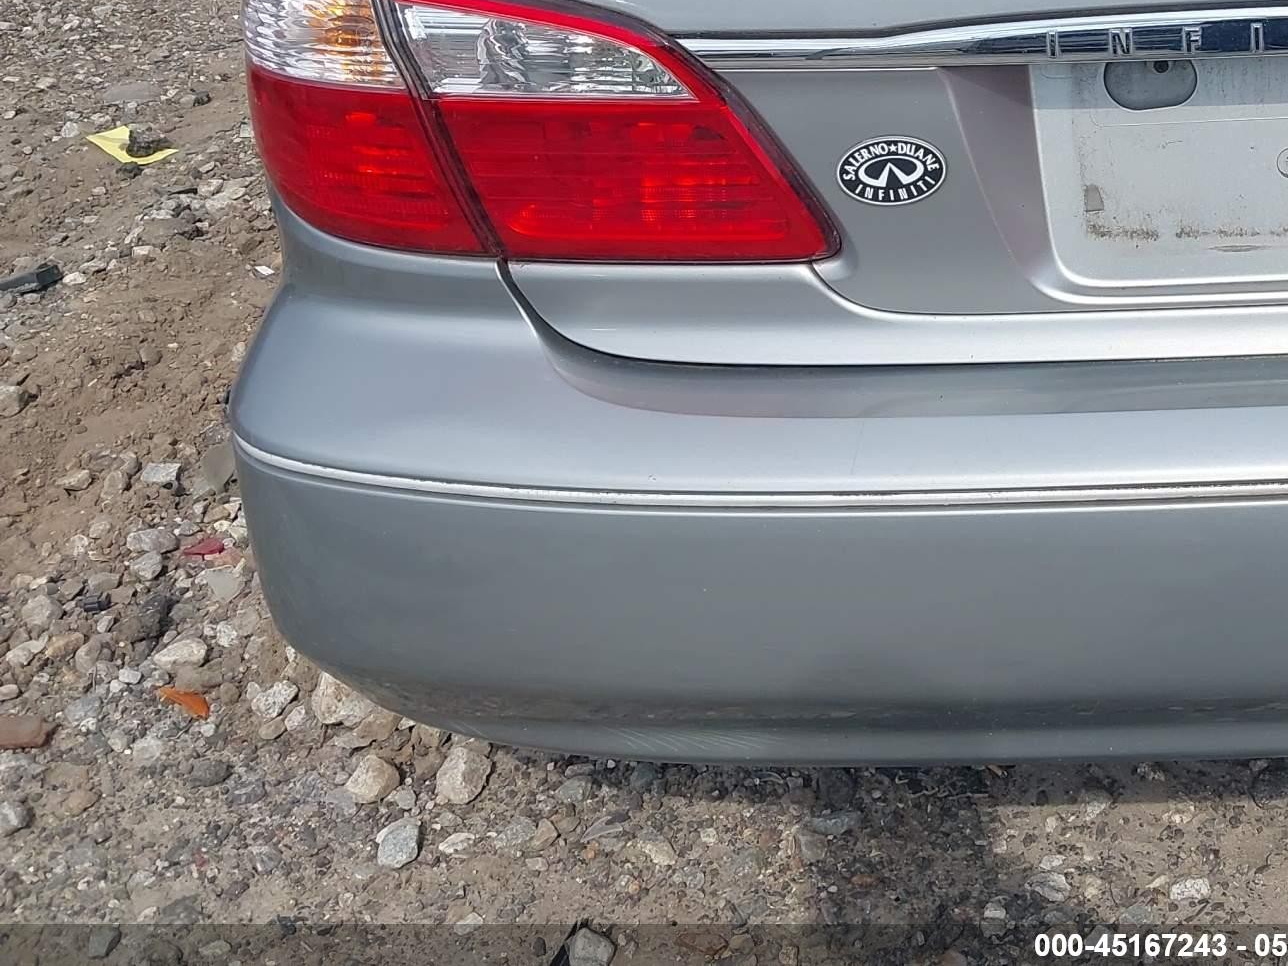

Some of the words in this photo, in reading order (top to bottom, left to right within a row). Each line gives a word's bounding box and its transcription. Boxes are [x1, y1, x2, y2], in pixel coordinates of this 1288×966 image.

[843, 142, 889, 181] SALERNO
[897, 142, 940, 171] DUANE
[855, 176, 936, 201] INFINITI
